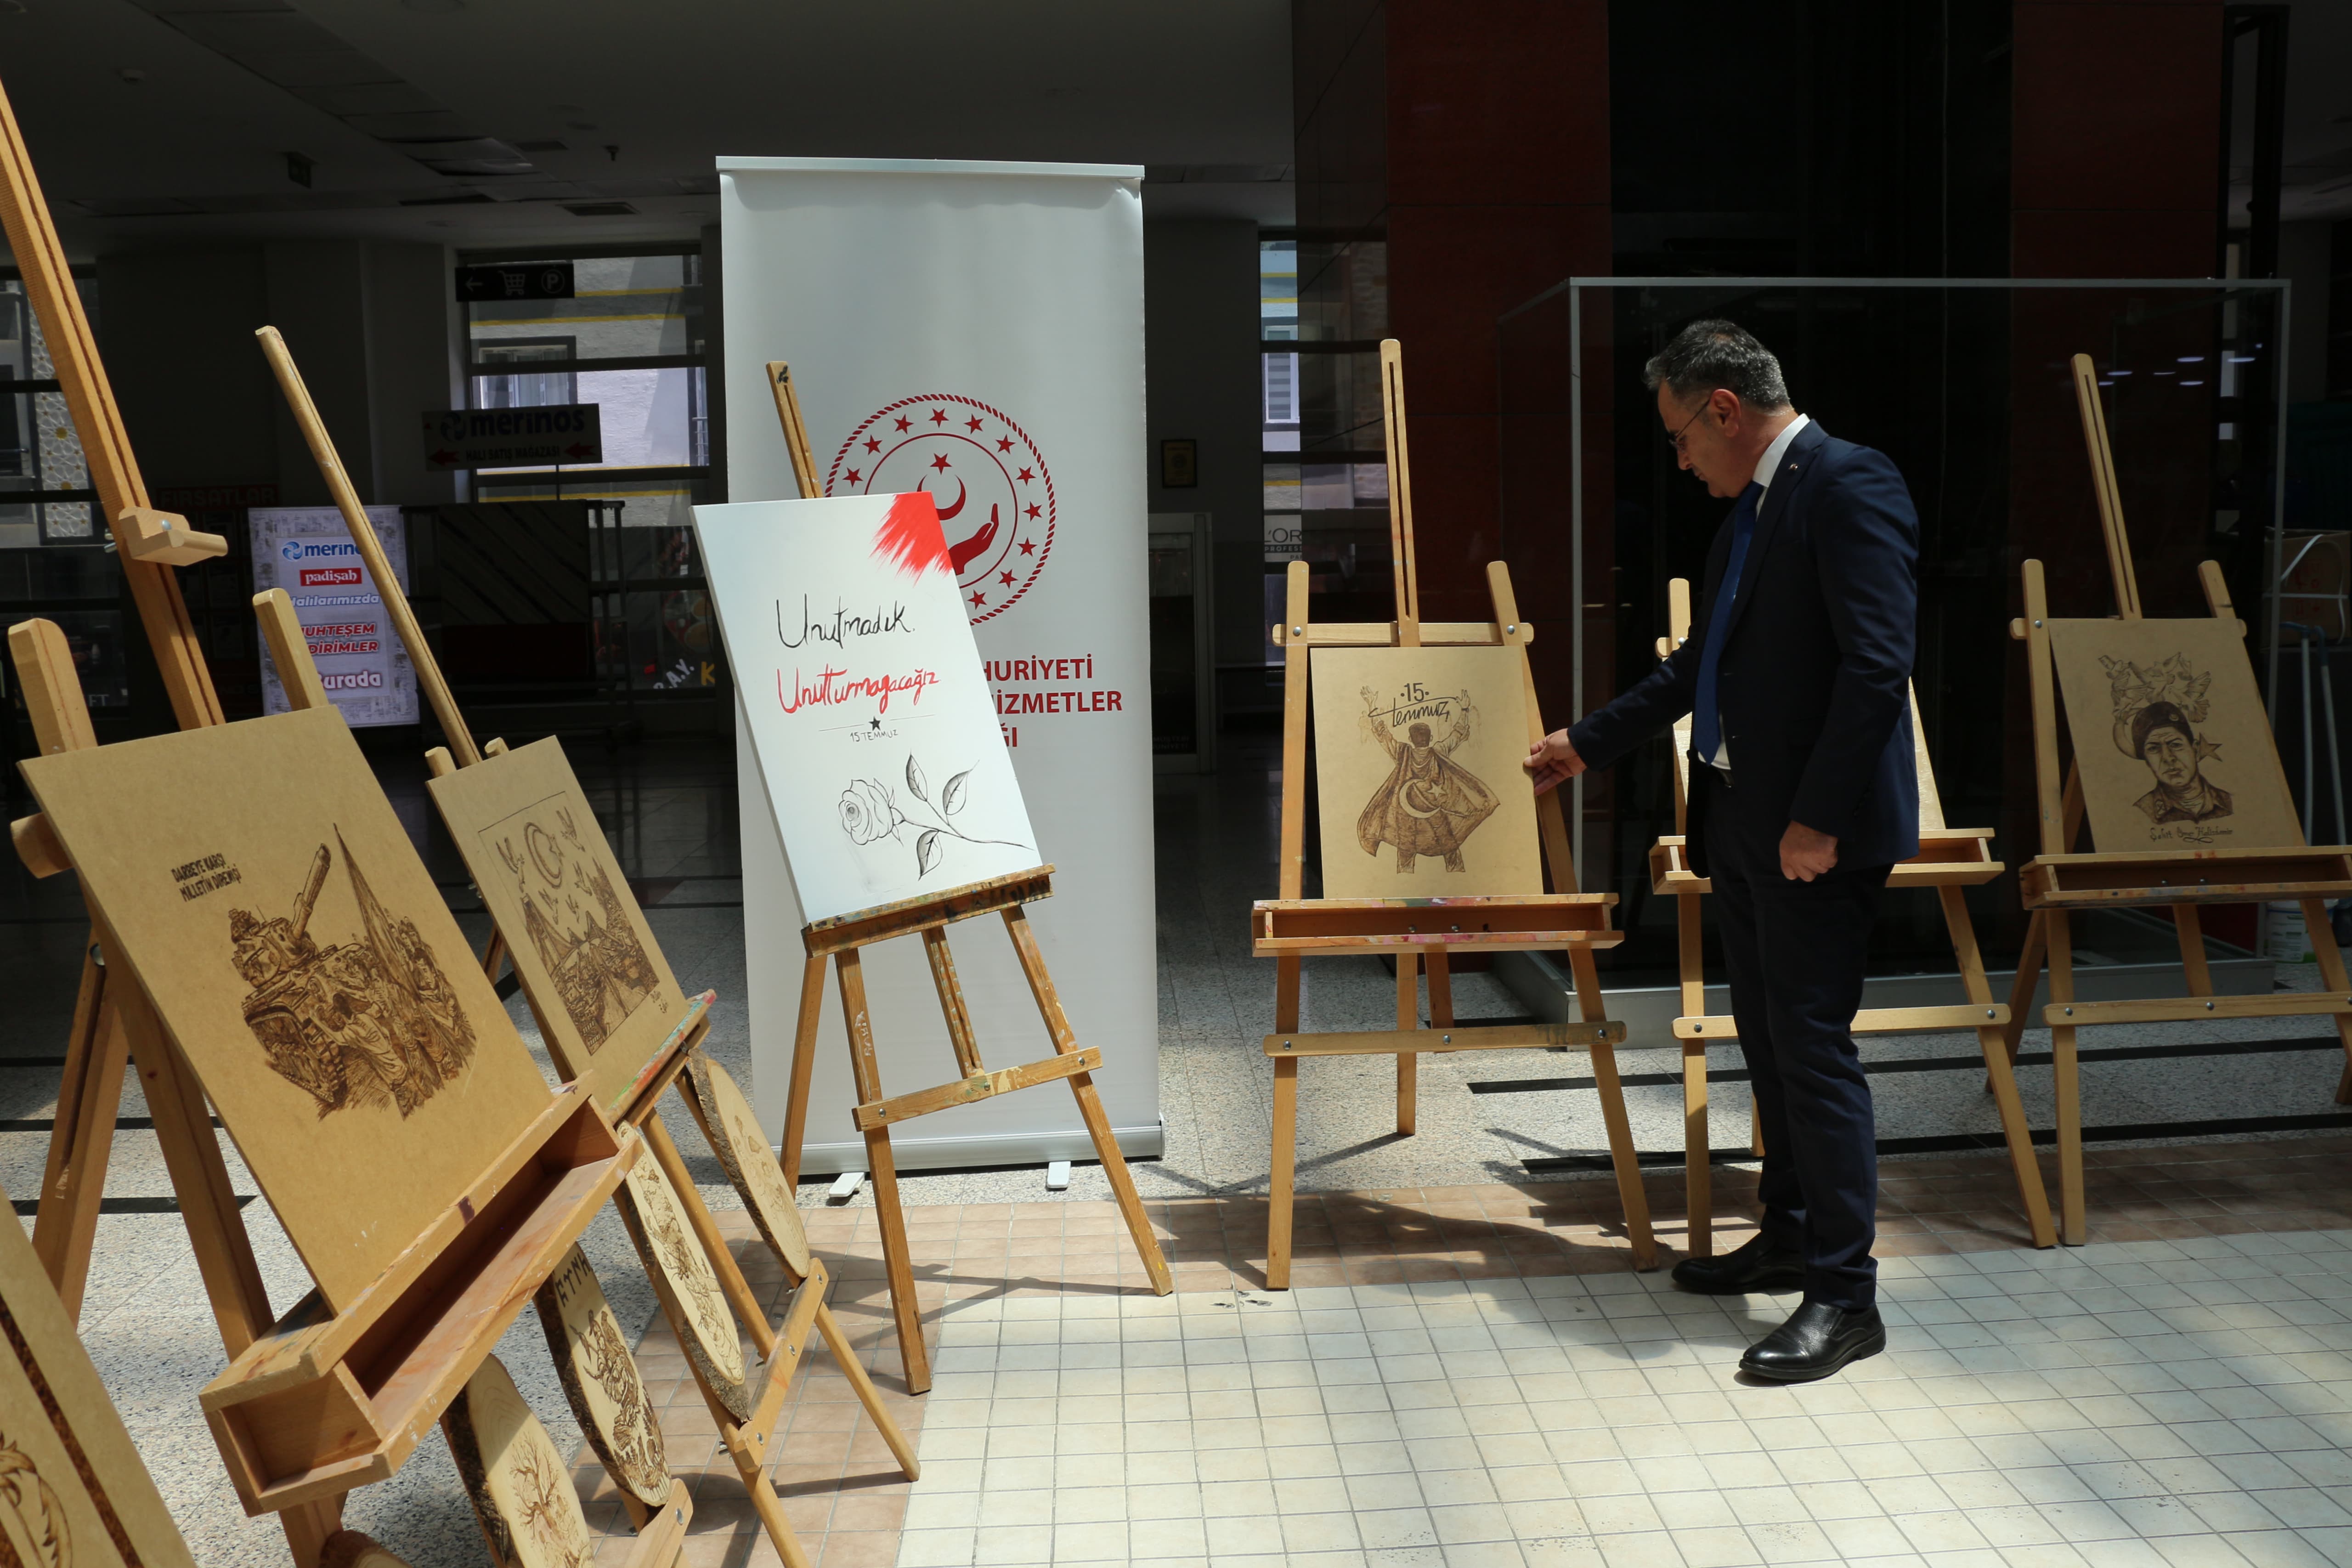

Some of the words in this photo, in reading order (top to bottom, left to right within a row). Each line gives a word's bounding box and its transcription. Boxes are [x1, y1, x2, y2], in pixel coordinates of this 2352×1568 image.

[470, 410, 585, 436] merinos
[466, 448, 486, 461] HALI
[488, 447, 512, 461] SATIŞ
[515, 444, 560, 459] MAĞAZASI
[161, 487, 275, 507] FIRSATLAR
[305, 570, 357, 585] padişah
[991, 689, 1122, 714] İZMETLER
[850, 732, 860, 742] 15
[860, 730, 899, 741] TEMMUZ
[171, 860, 206, 883] DARBEYE
[203, 853, 226, 871] KARŞI
[179, 875, 215, 902] MİLLETİN
[211, 863, 242, 889] DİRENİŞİ
